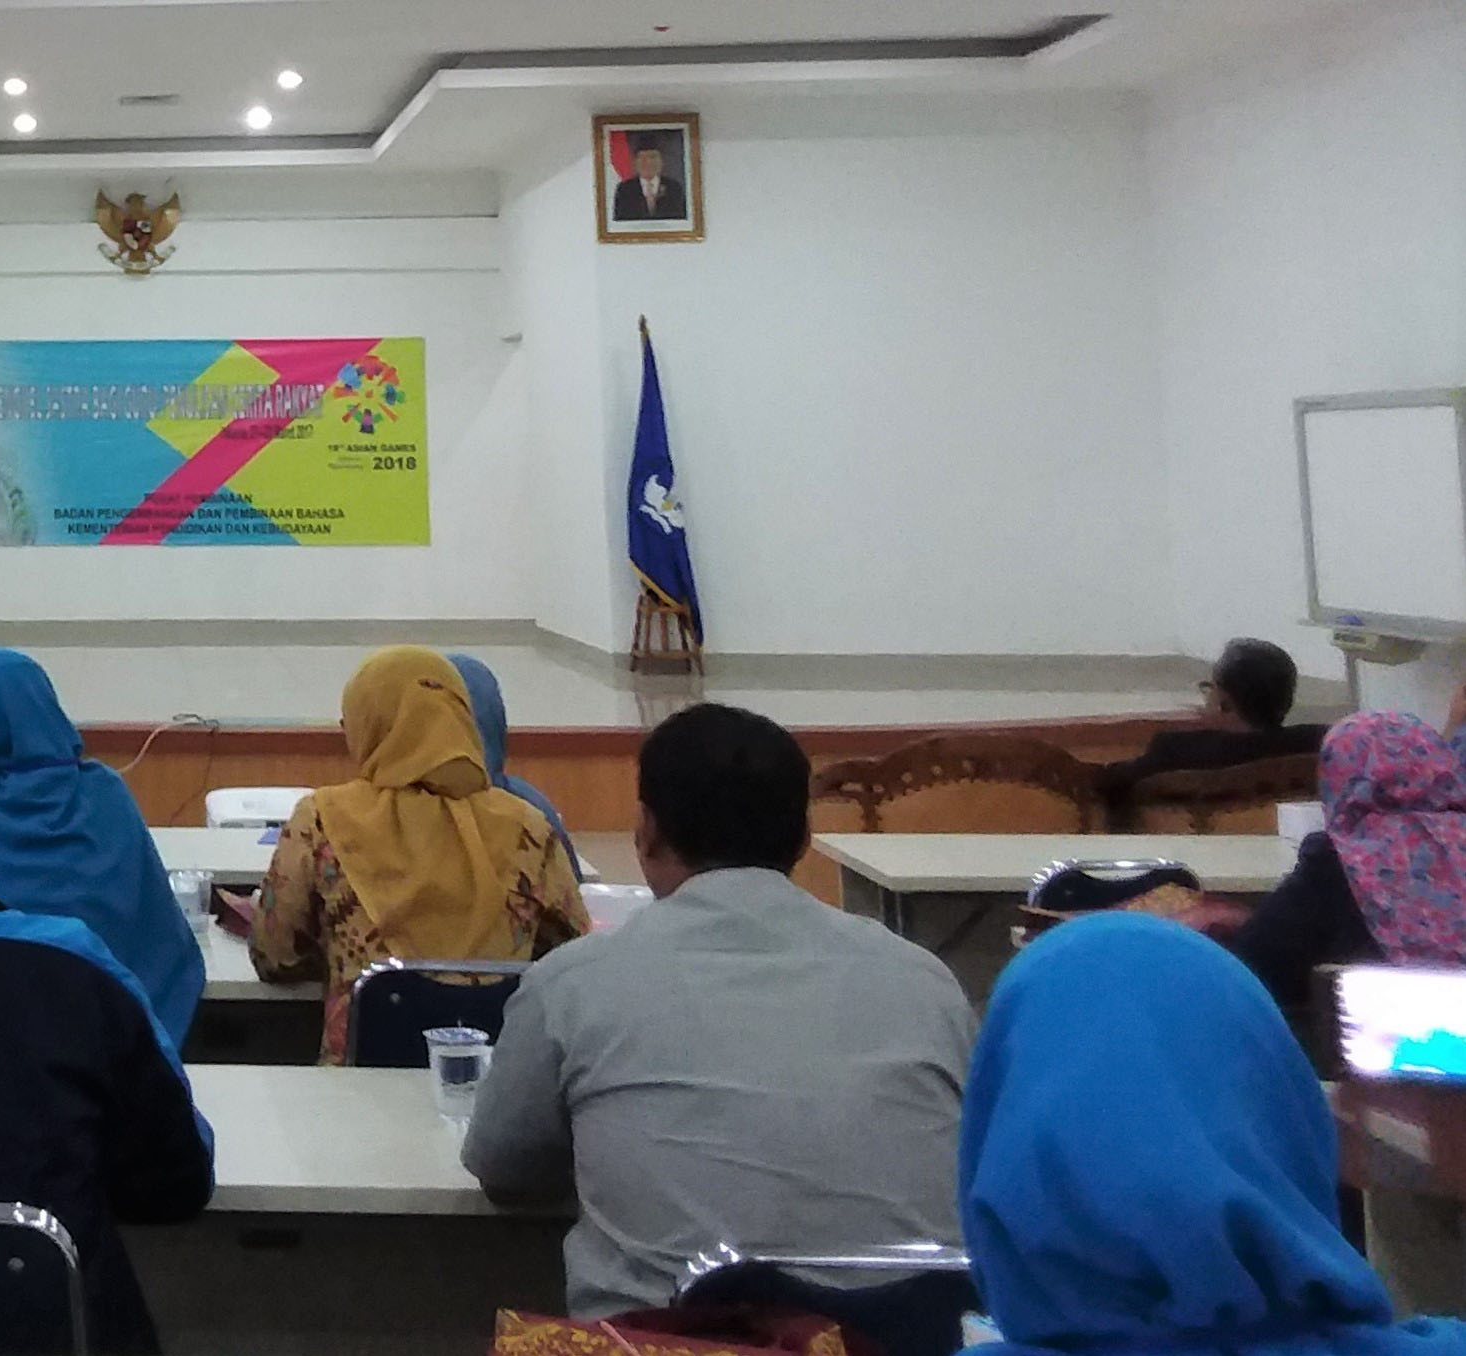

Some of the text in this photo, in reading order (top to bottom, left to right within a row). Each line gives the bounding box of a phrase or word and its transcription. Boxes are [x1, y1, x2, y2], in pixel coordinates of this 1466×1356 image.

[275, 384, 324, 420] RAKYAT
[372, 456, 417, 471] 2018
[53, 507, 94, 520] BADAN
[197, 507, 222, 520] DAN
[224, 507, 294, 520] PEMBINAAN
[295, 507, 345, 520] BAHASA
[224, 522, 250, 535] DAN
[252, 522, 332, 535] KEBUDAYAAN
